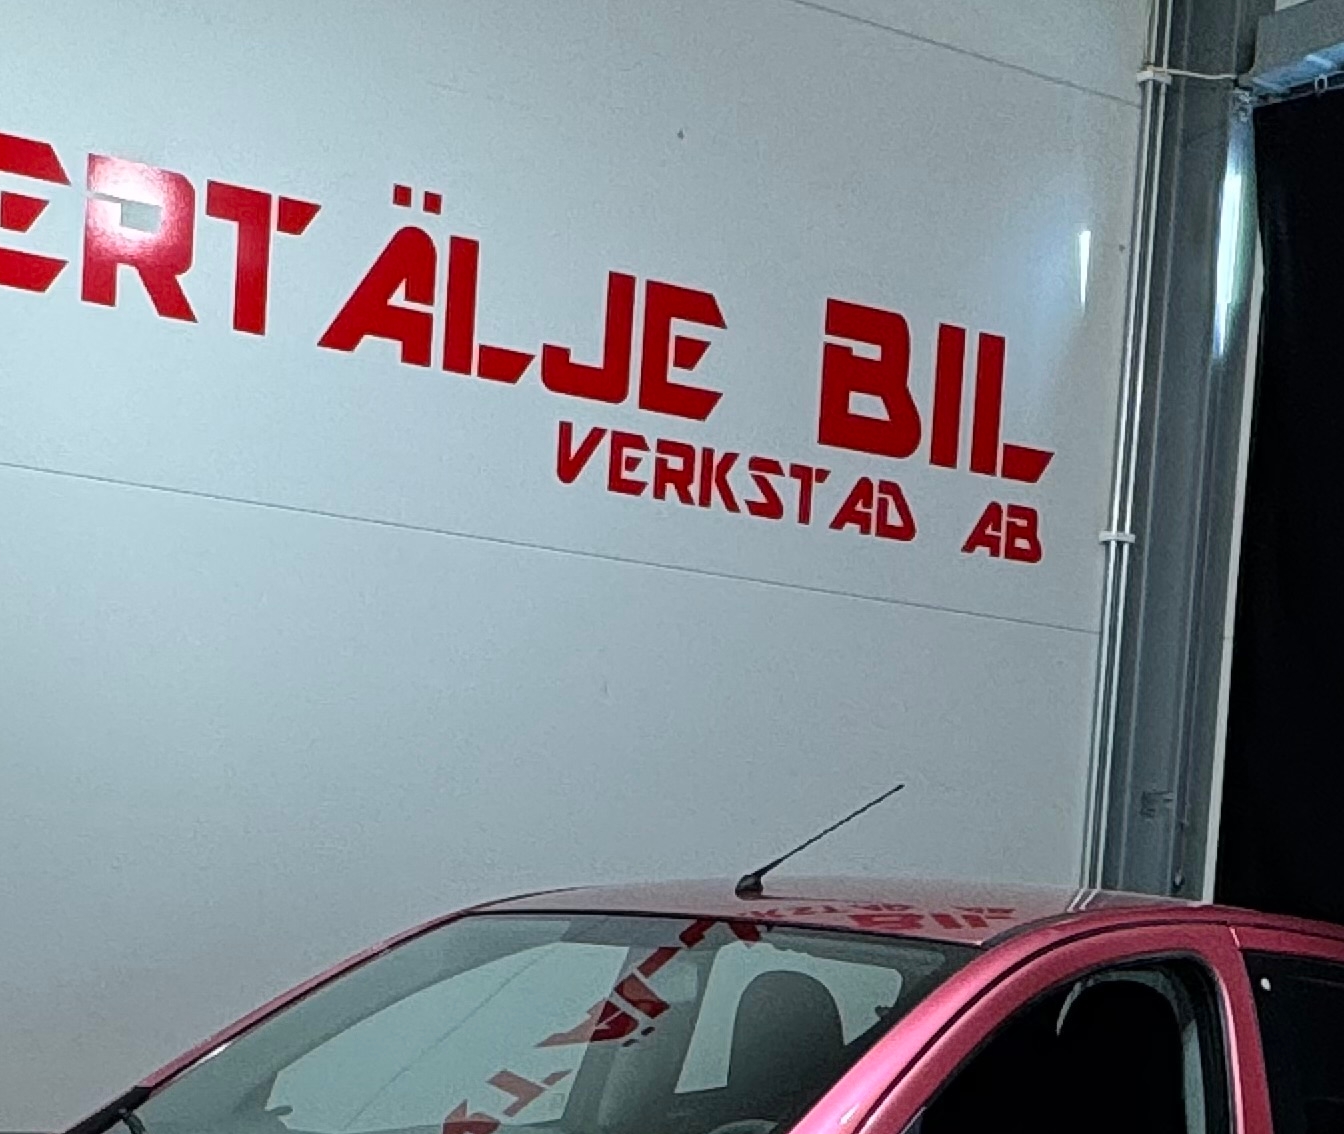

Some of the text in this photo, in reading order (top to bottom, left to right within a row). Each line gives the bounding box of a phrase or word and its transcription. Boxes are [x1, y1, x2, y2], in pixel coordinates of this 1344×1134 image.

[817, 299, 1055, 484] BIL
[556, 420, 1043, 564] VERKSTAD AB
